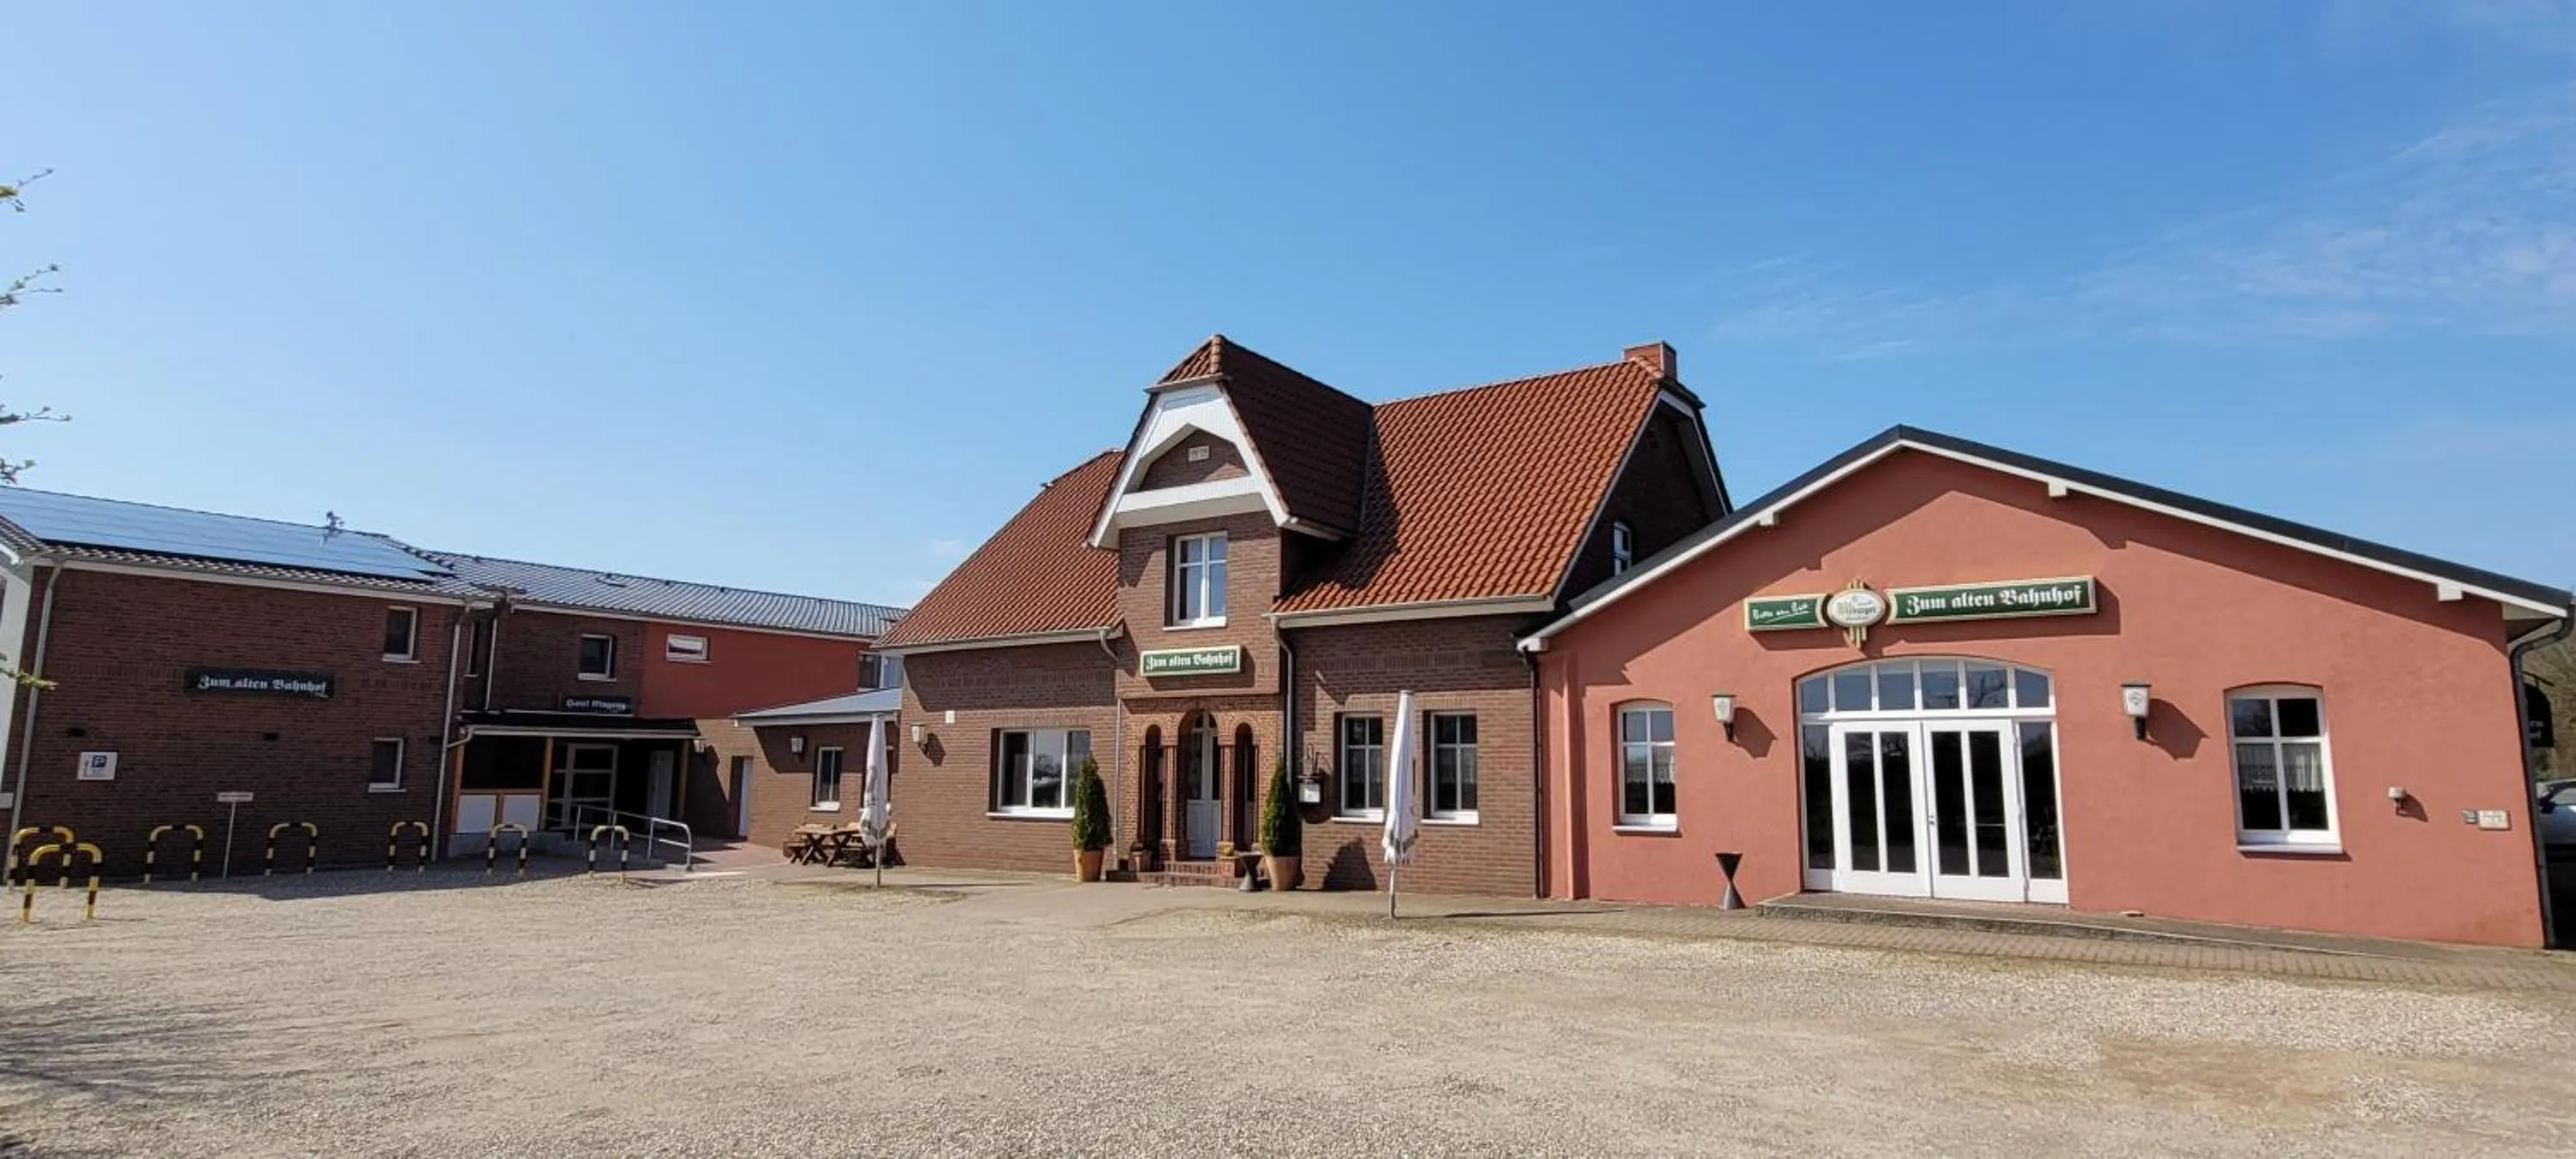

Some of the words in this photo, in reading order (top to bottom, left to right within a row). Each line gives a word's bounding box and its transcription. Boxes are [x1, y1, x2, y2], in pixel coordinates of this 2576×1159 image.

[1906, 595, 1946, 615] Zum
[1952, 592, 1995, 609] alten
[1999, 585, 2082, 607] Bahnhof
[1146, 655, 1166, 671] Zum
[1169, 655, 1191, 666] alten
[1193, 652, 1234, 667] Bahnhof
[197, 674, 231, 689] Zum
[234, 677, 268, 689] alten
[272, 678, 327, 695] Bahnhof
